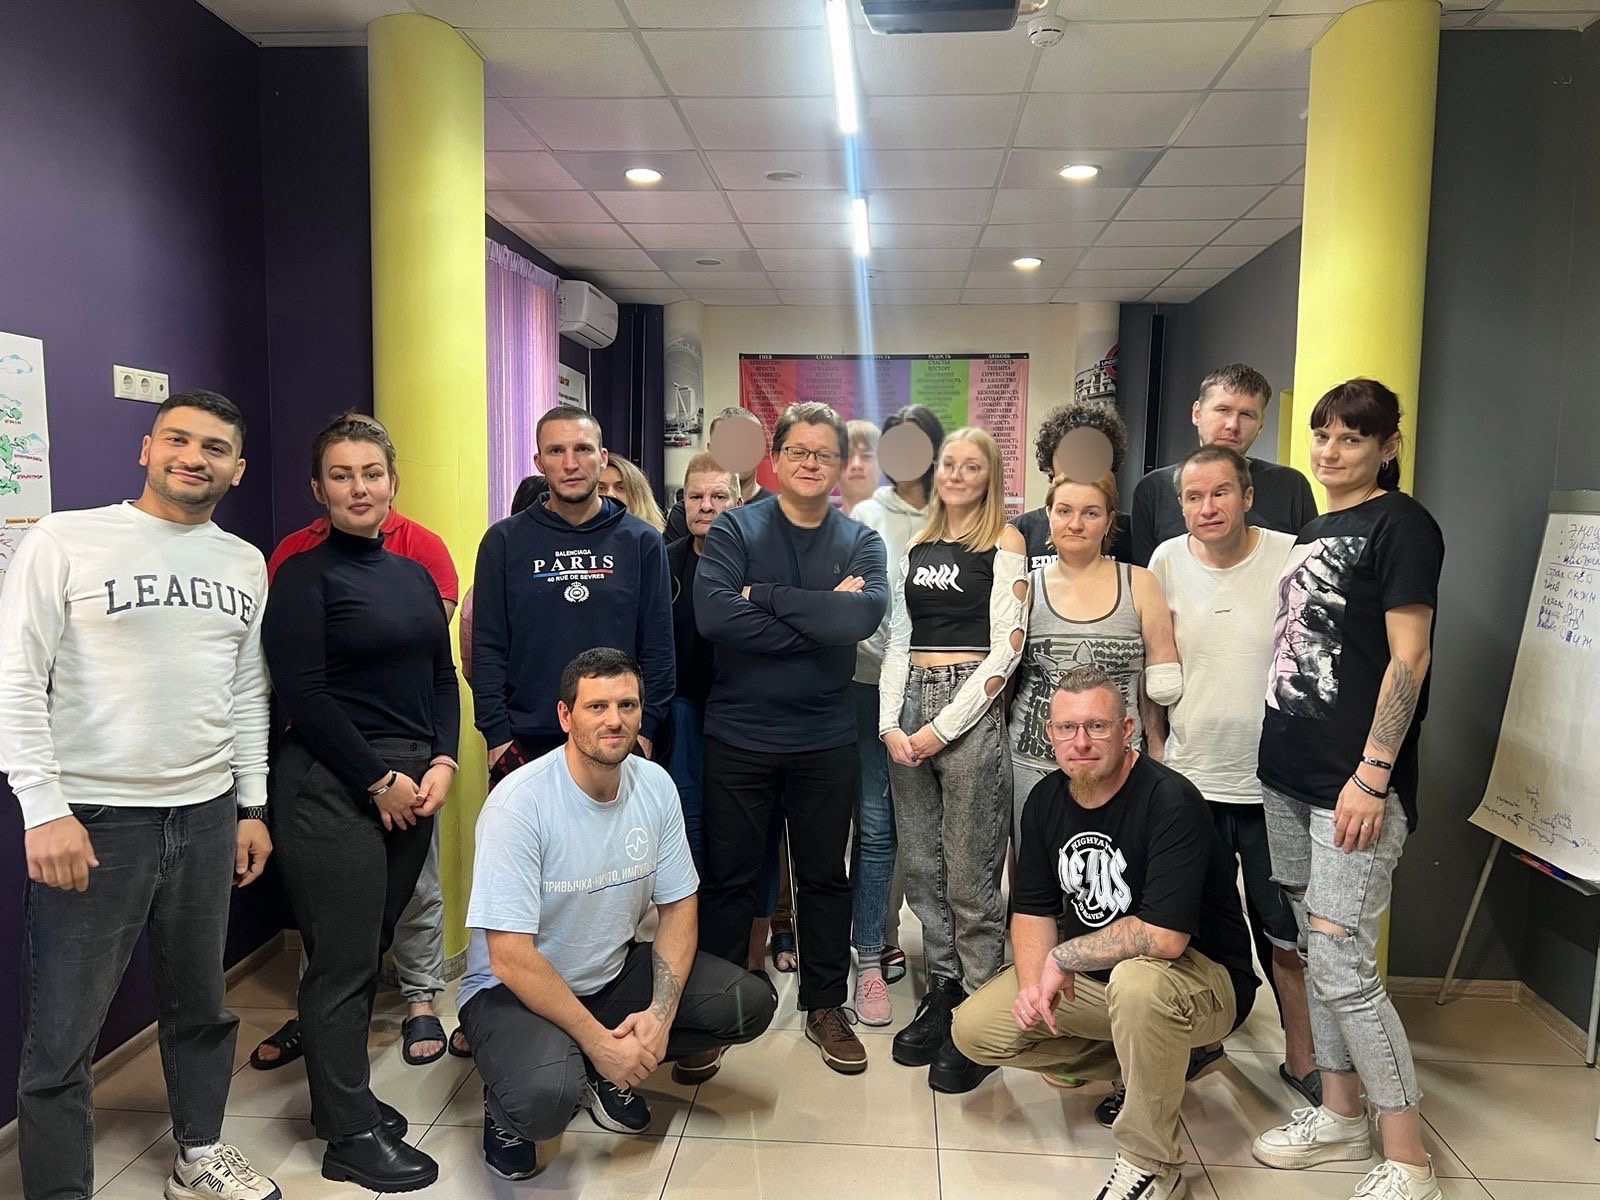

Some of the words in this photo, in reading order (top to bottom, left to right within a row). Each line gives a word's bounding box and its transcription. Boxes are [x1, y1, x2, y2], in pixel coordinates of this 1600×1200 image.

[554, 549, 592, 557] BALENCIAGA
[533, 555, 614, 573] PARIS
[104, 574, 255, 626] LEAGUE
